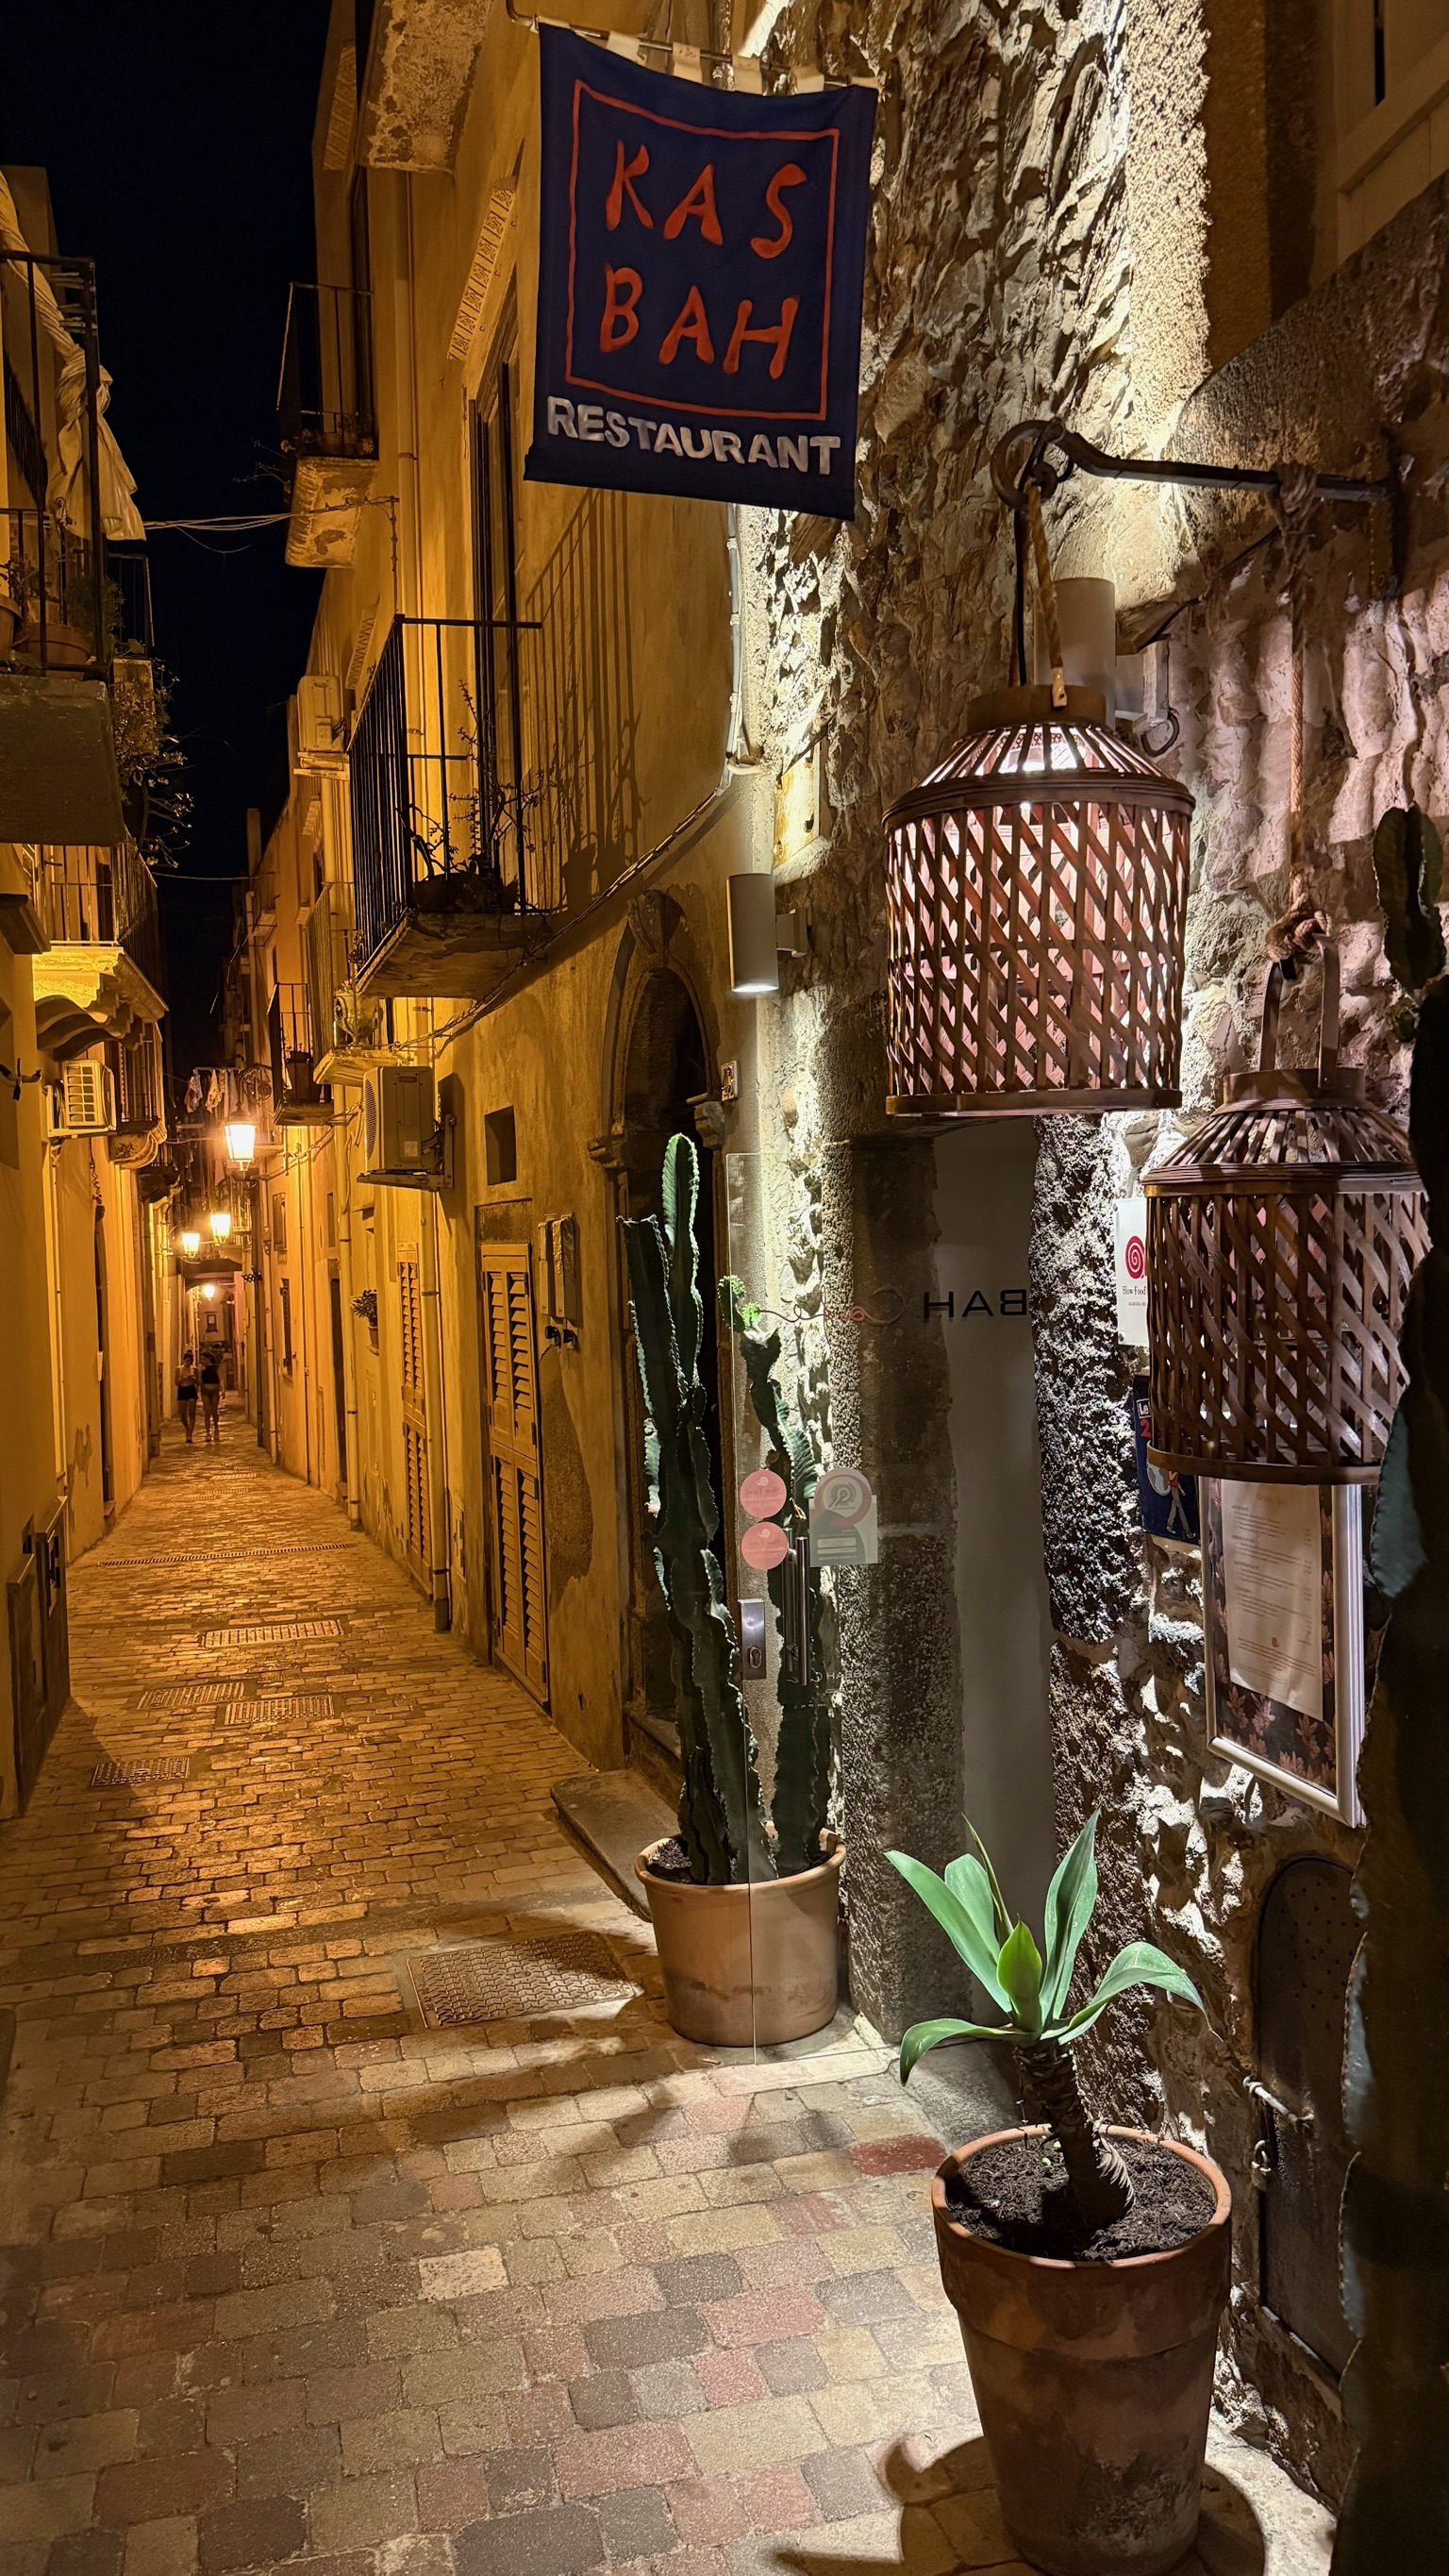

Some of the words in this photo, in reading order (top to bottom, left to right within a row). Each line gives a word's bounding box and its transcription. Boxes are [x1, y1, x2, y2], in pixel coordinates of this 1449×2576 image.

[606, 140, 808, 259] KAS
[599, 263, 800, 379] BAH
[546, 396, 841, 476] RESTAURANT
[1123, 1286, 1133, 1296] Slow
[1134, 1286, 1146, 1296] Food
